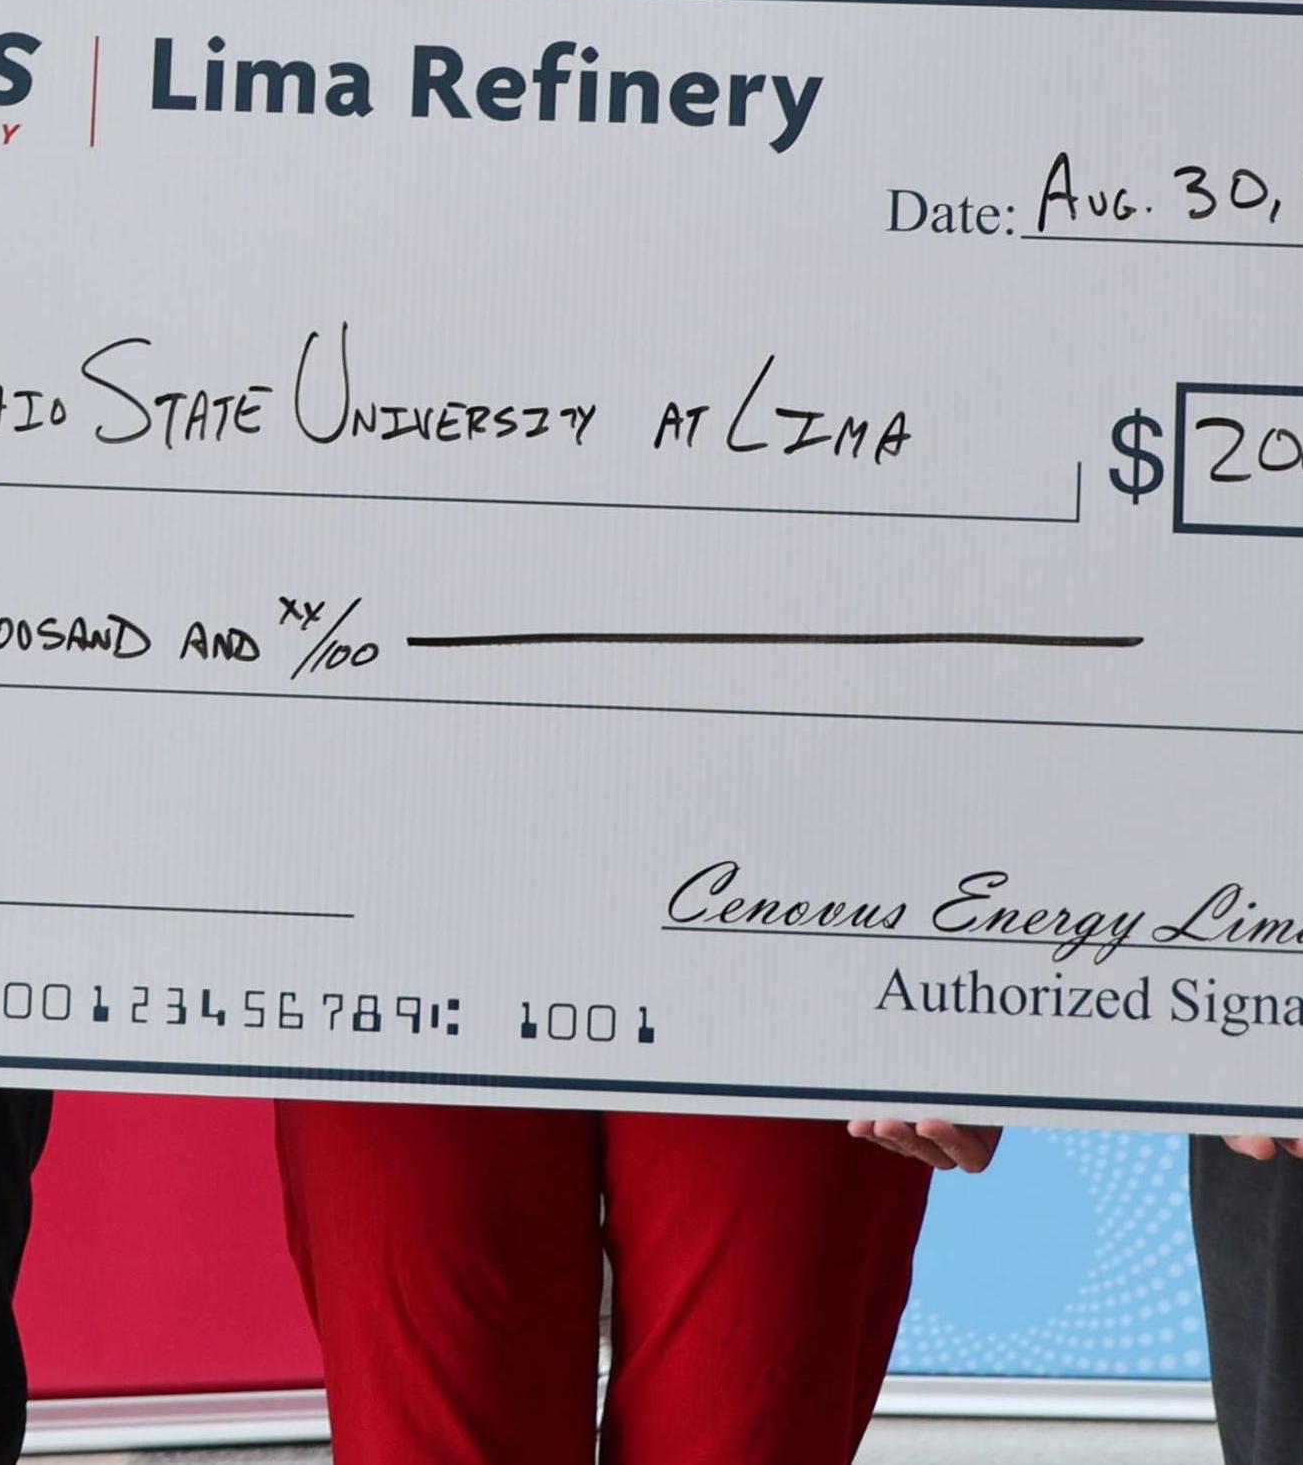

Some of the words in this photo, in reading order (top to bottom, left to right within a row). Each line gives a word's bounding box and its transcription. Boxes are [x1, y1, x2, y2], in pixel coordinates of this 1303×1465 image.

[152, 36, 374, 117] Lima
[412, 41, 823, 154] Refinery
[889, 190, 1014, 235] Date:
[1174, 166, 1280, 223] 30,
[82, 338, 273, 449] STATE
[654, 402, 709, 449] AT
[727, 355, 911, 465] LIMA
[1109, 408, 1164, 505] $
[180, 622, 260, 661] AND
[667, 860, 906, 931] Cenovus
[932, 870, 1146, 965] Energy
[521, 1002, 654, 1043] 1001
[876, 966, 1151, 1023] Authorized
